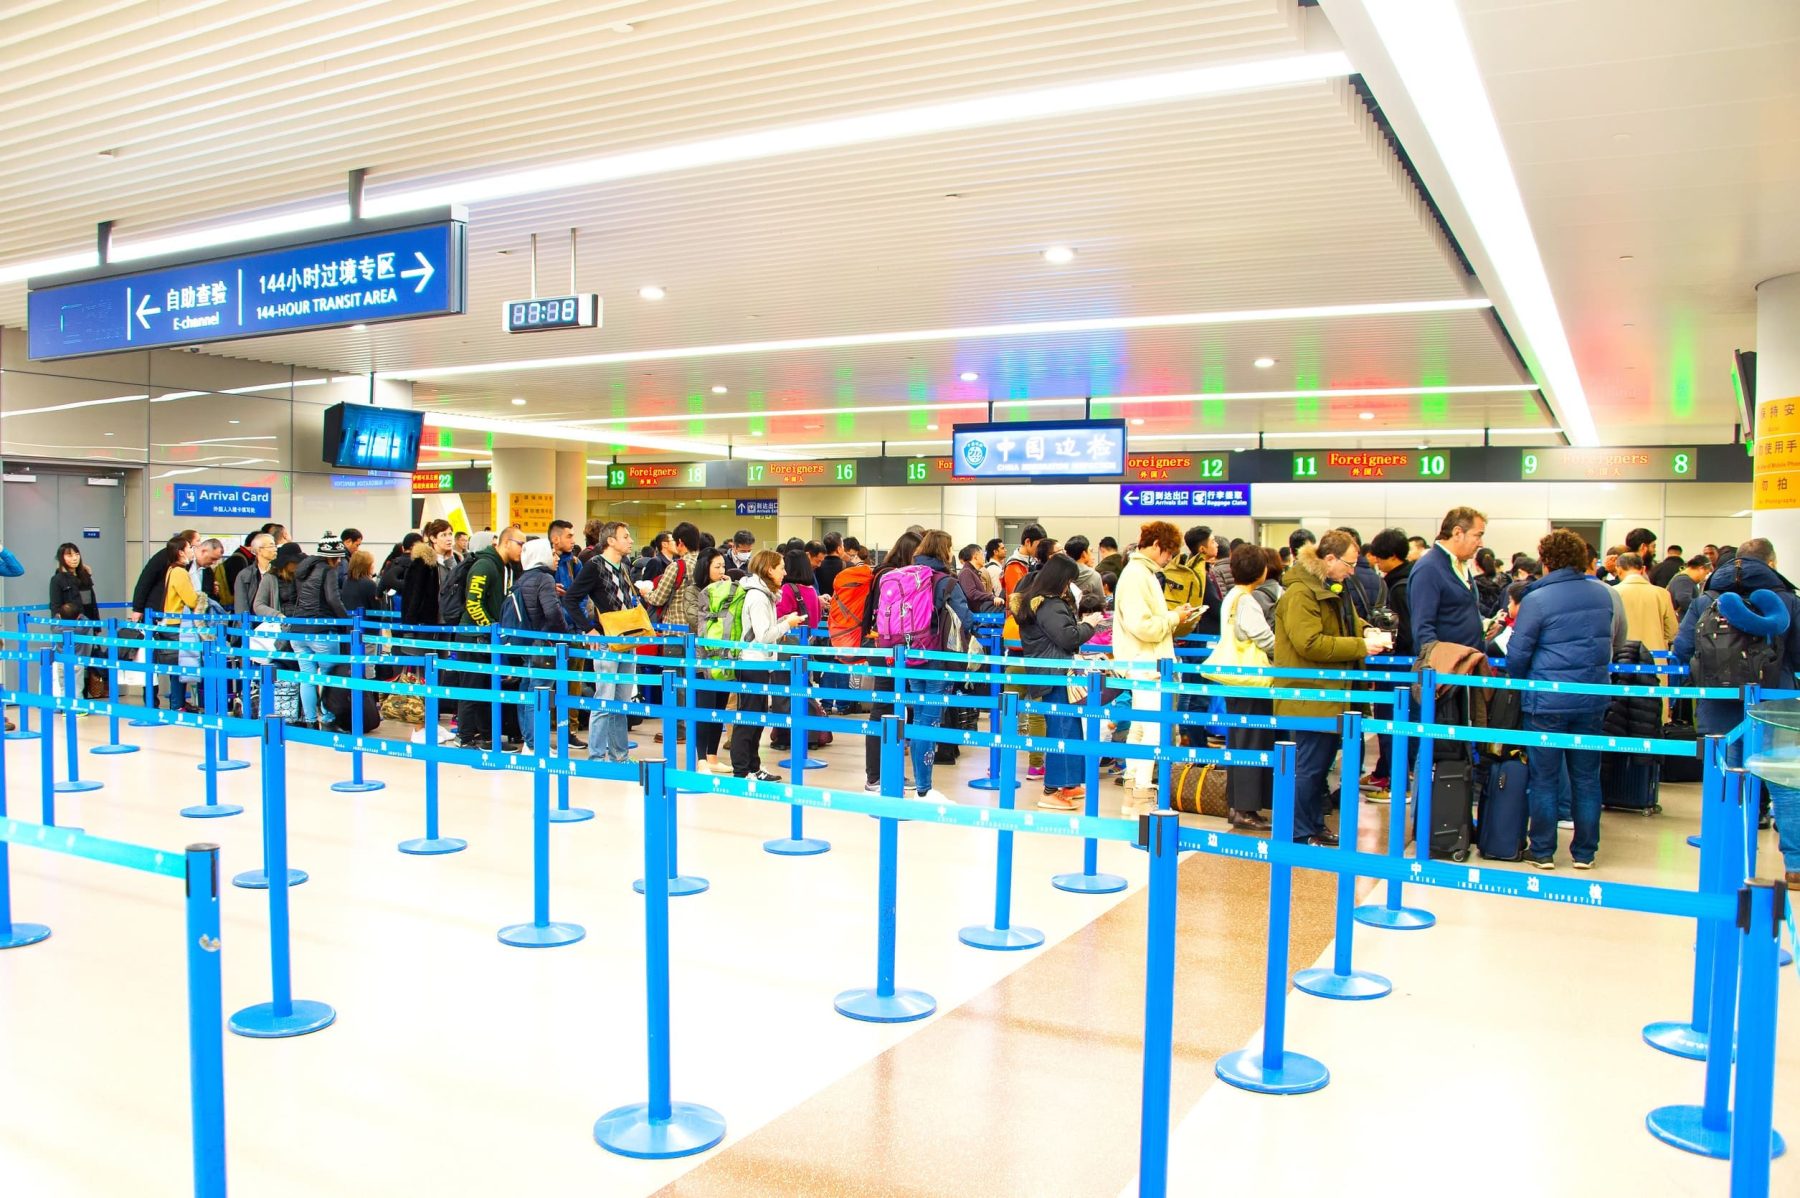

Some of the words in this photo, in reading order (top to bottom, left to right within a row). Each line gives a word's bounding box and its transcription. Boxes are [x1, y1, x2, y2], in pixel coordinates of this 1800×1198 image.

[258, 252, 396, 294] 144小时过境专区
[166, 280, 228, 312] 自助查验
[256, 301, 310, 320] 144-HOUR
[312, 294, 361, 313] TRANSIT
[363, 287, 398, 305] AREA
[173, 311, 220, 331] E-channel
[996, 433, 1117, 462] 中国边检
[1128, 456, 1191, 468] oreigners
[1201, 459, 1223, 477] 12
[1295, 456, 1317, 475] 11
[1330, 453, 1408, 466] Foreigners
[1420, 455, 1445, 475] 10
[1524, 454, 1538, 474] 9
[1674, 453, 1688, 474] 8
[611, 470, 625, 485] 19
[629, 467, 677, 477] Foreigners
[688, 468, 702, 482] 18
[749, 465, 763, 481] 17
[770, 463, 824, 475] Foreigners
[836, 464, 853, 480] 16
[909, 463, 926, 480] 15
[438, 474, 452, 488] 22
[199, 490, 239, 501] Arrival
[242, 491, 269, 502] Card
